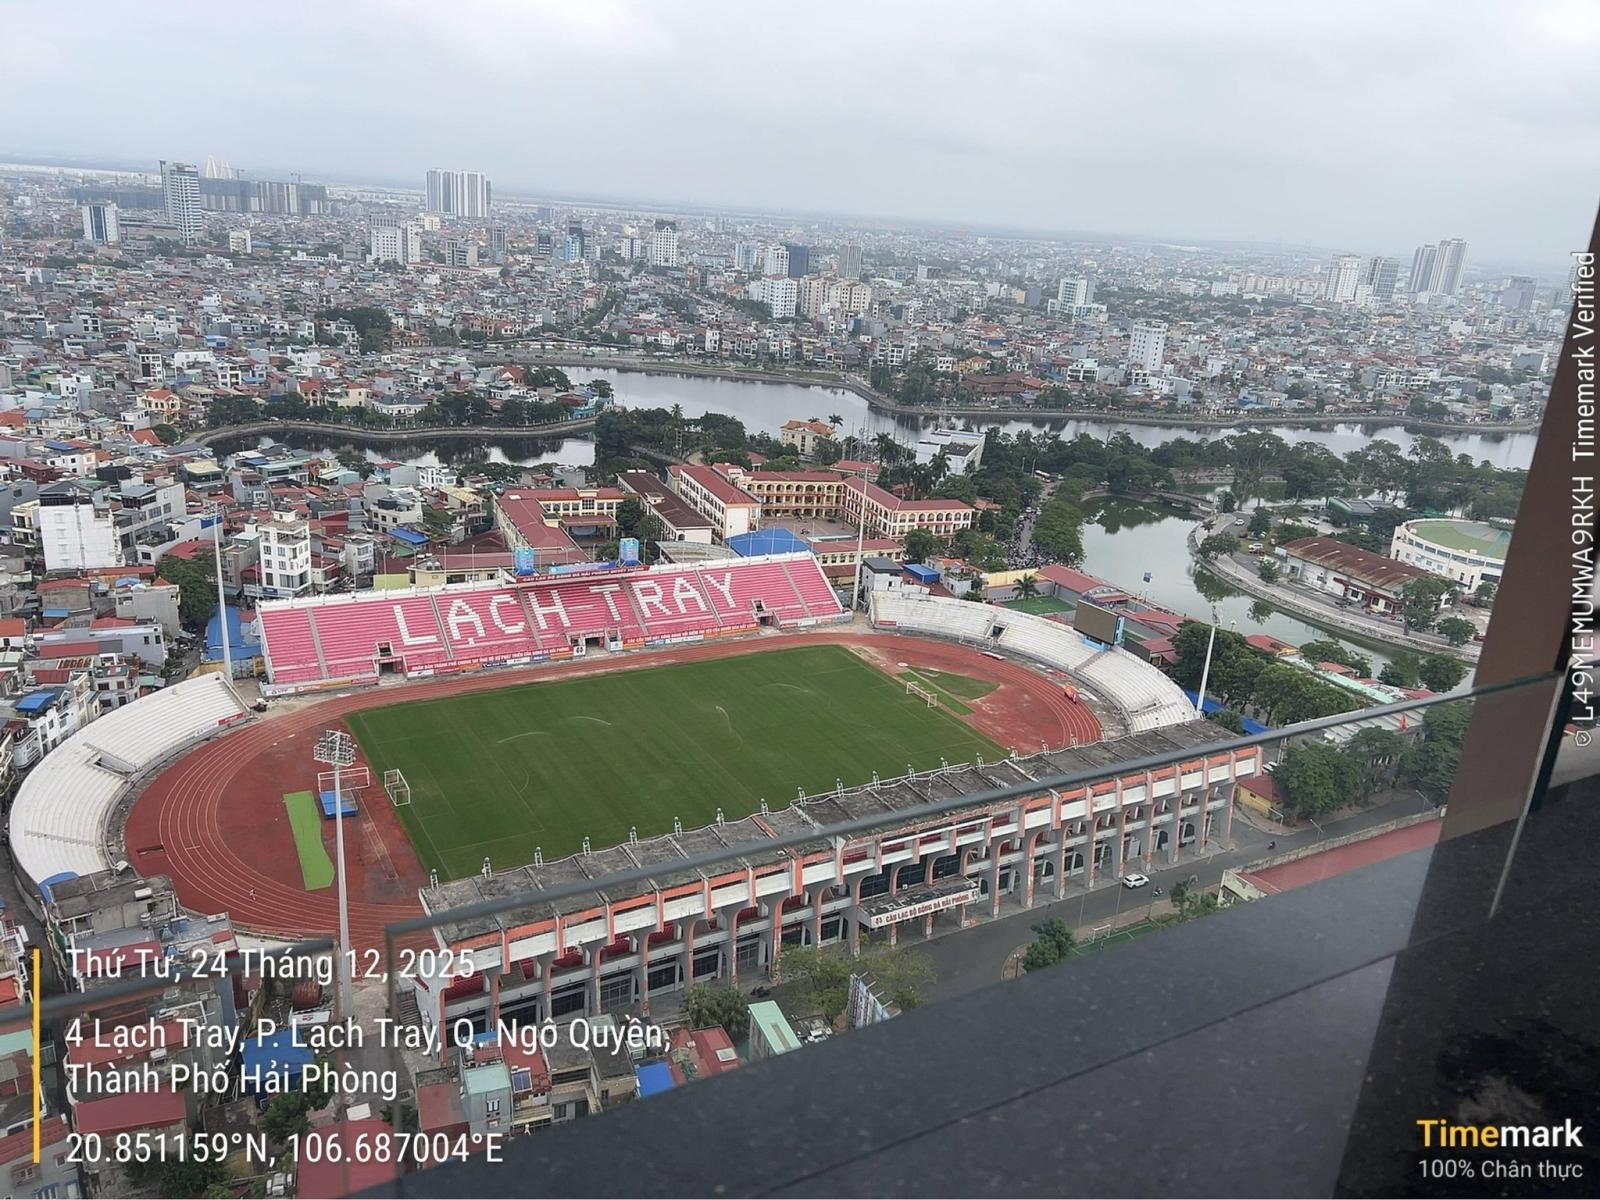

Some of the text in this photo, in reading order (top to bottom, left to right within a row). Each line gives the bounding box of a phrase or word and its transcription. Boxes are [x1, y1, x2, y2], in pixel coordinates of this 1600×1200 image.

[393, 589, 572, 645] LẠCH
[589, 573, 736, 621] TRAY
[885, 914, 896, 922] CÂU
